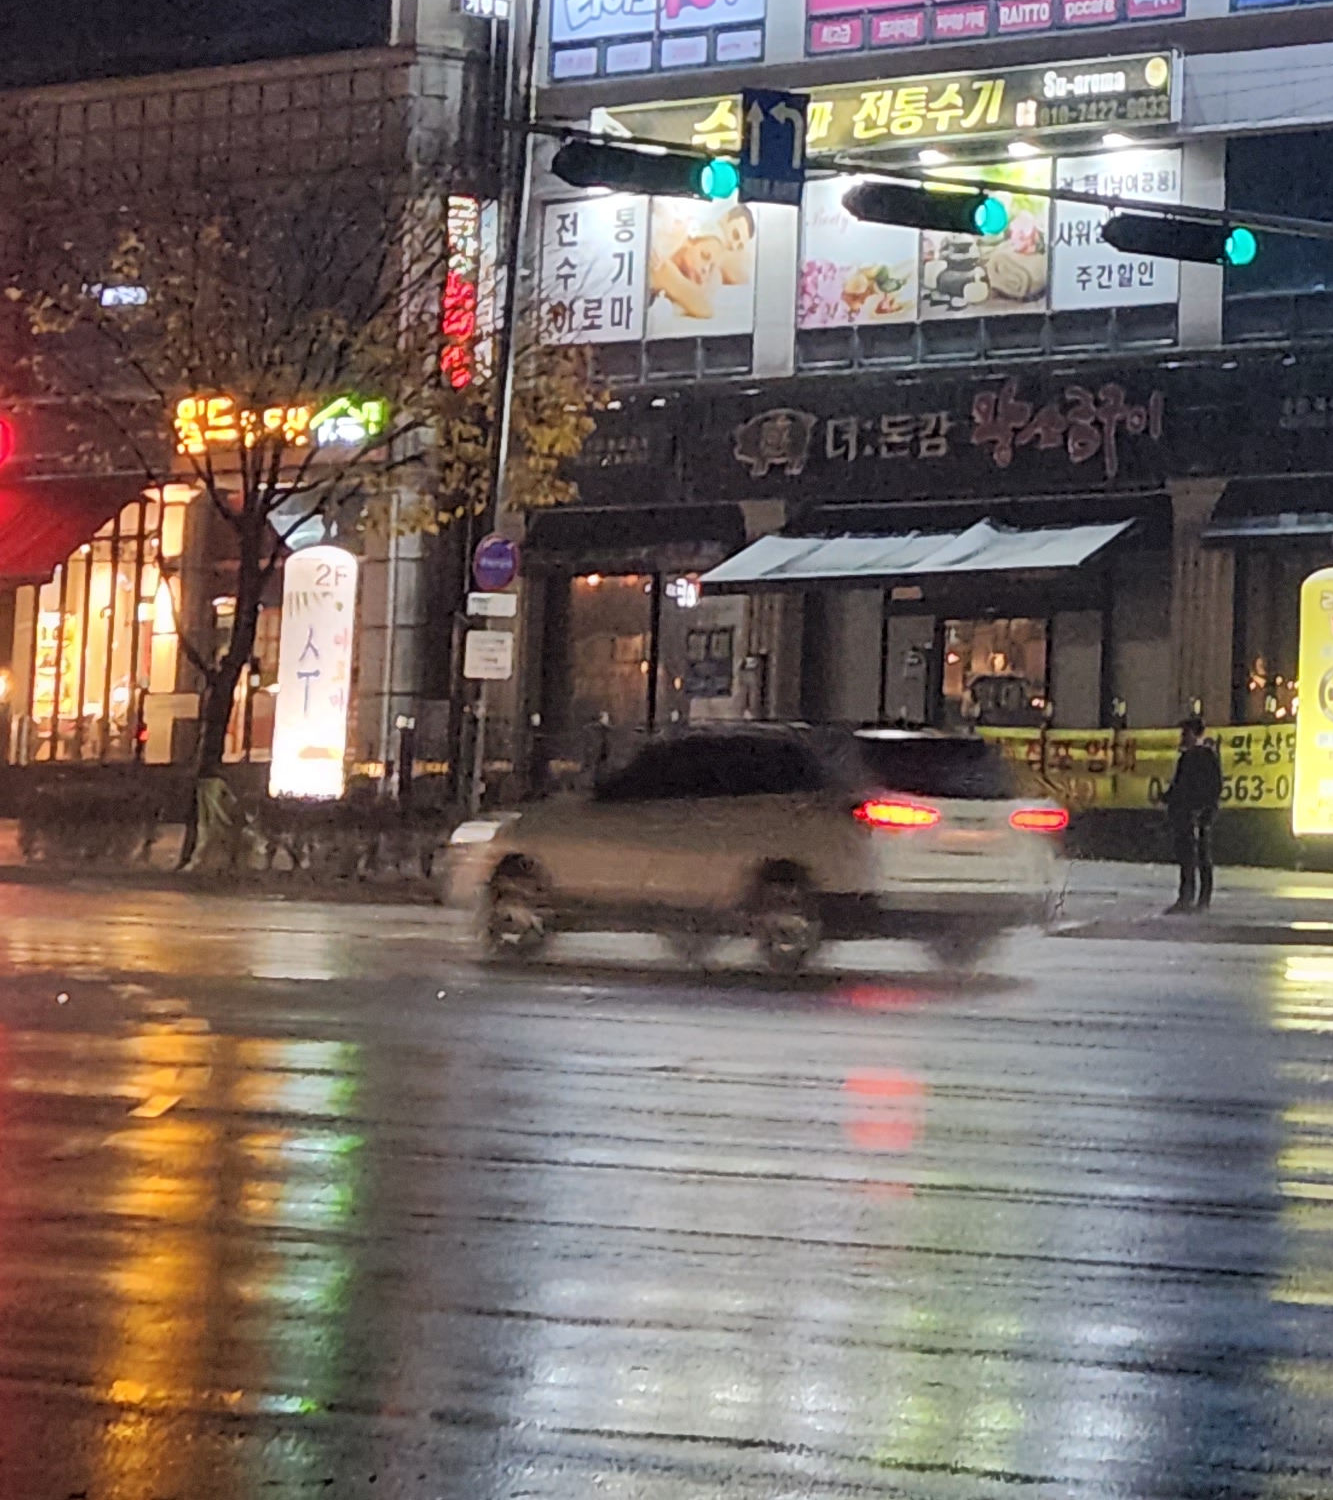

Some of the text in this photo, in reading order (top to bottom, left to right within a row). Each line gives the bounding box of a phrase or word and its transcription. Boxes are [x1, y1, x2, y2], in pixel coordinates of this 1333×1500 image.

[1000, 3, 1050, 25] RAITTO
[853, 79, 1006, 140] 전통수기
[1075, 260, 1154, 291] 주간할인
[315, 563, 347, 588] 2F
